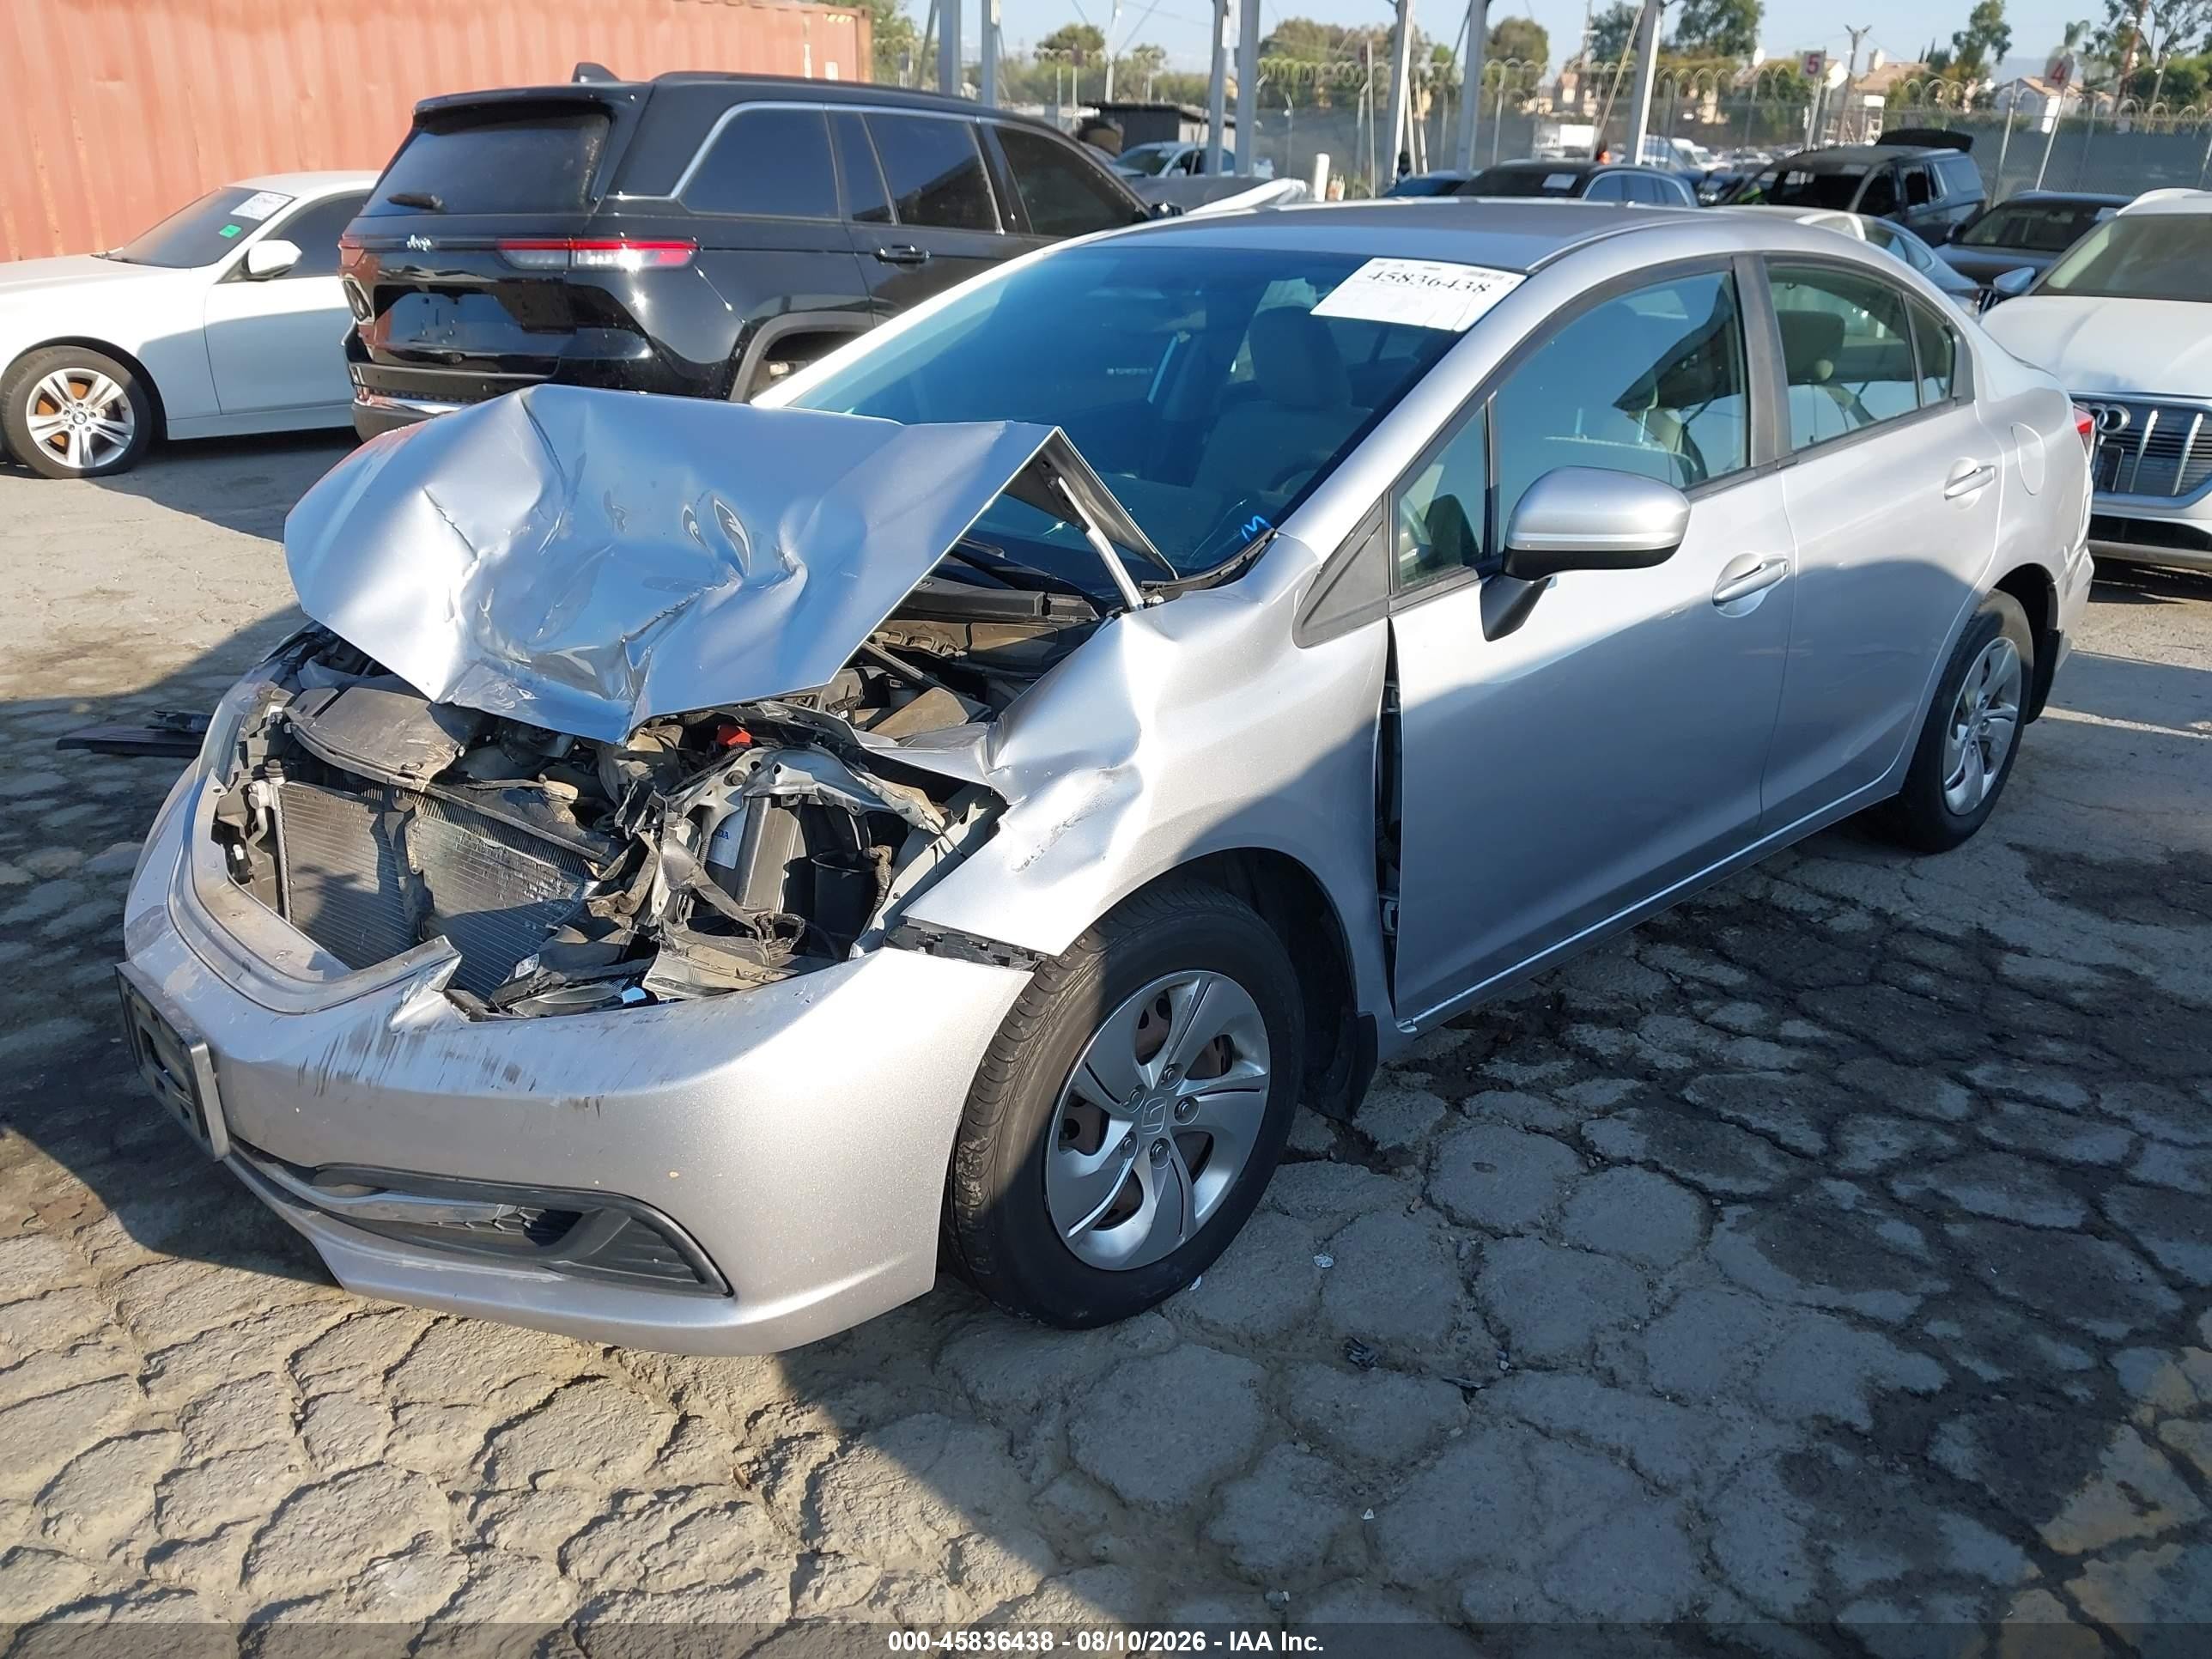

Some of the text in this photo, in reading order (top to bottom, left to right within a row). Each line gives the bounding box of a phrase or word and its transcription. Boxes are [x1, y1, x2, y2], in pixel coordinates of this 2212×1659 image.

[1806, 54, 1820, 75] 5
[2051, 61, 2066, 85] 4
[1367, 270, 1491, 293] 45836438
